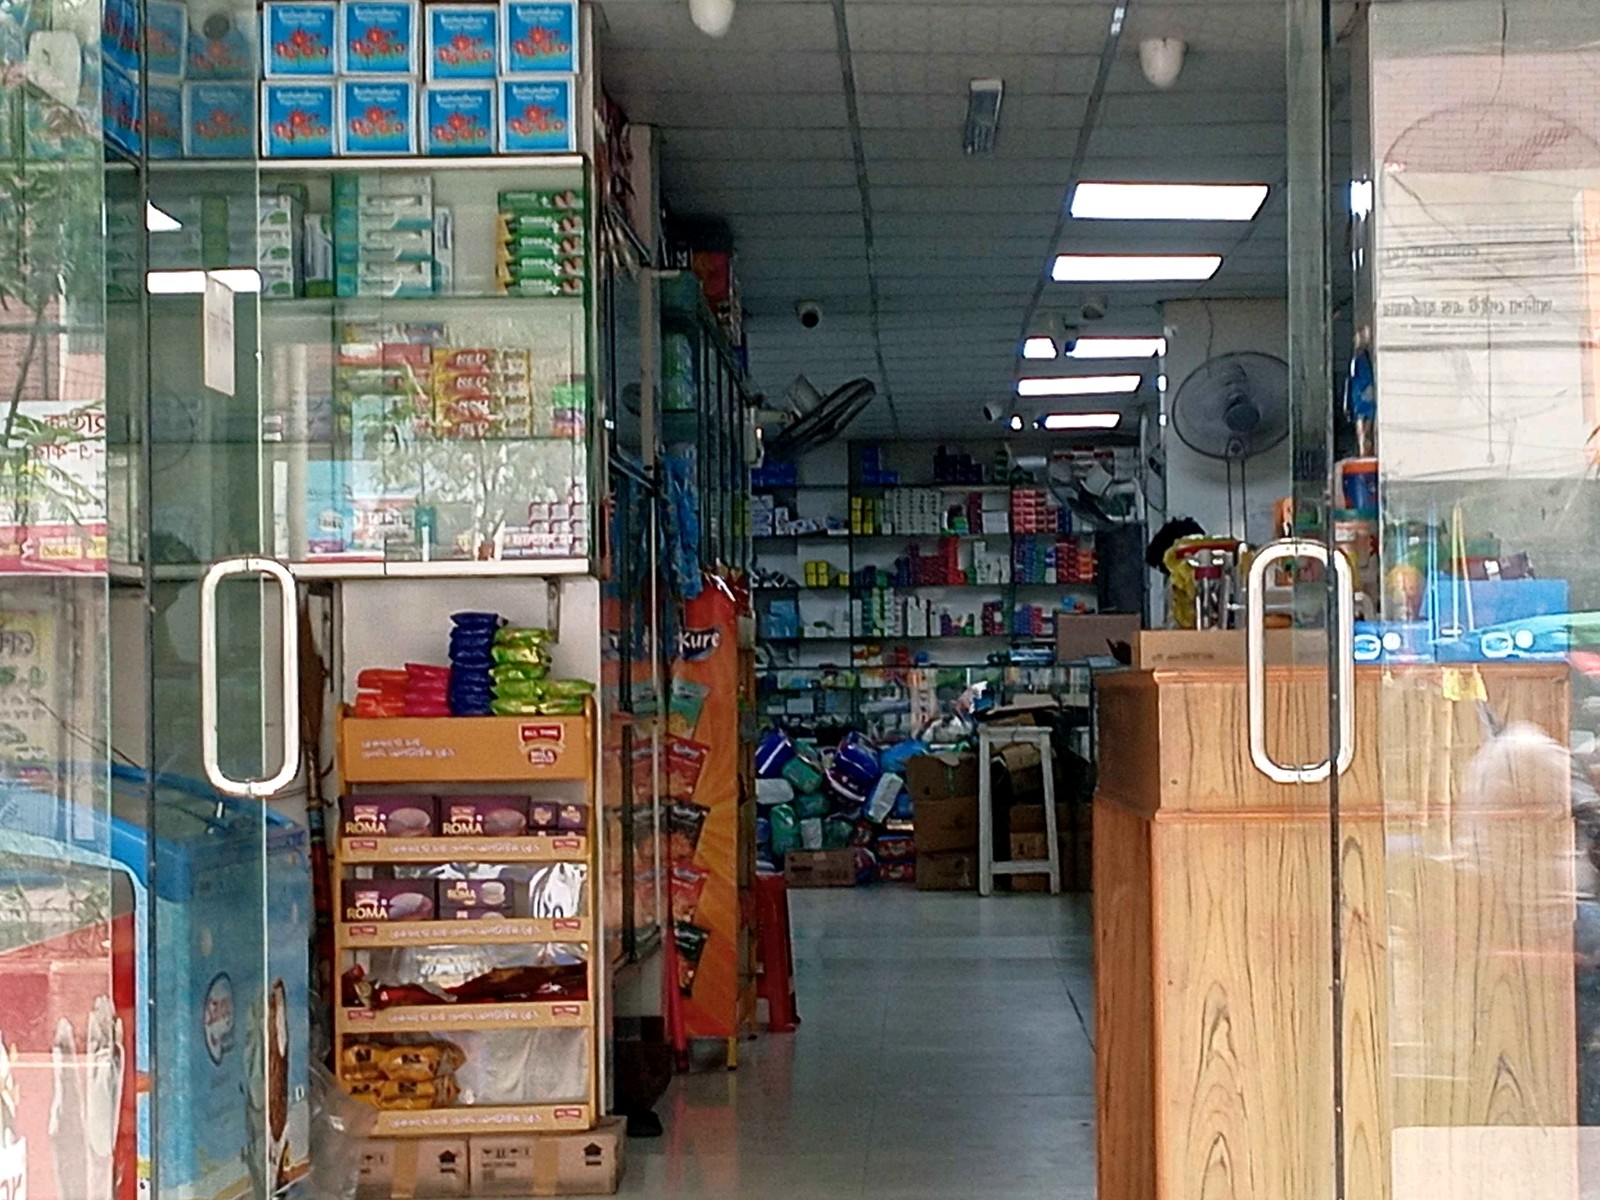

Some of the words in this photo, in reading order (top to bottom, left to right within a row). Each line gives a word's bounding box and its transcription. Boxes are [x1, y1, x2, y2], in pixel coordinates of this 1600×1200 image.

[345, 822, 387, 835] ROMA
[442, 822, 483, 835] ROMA
[346, 907, 388, 920] ROMA
